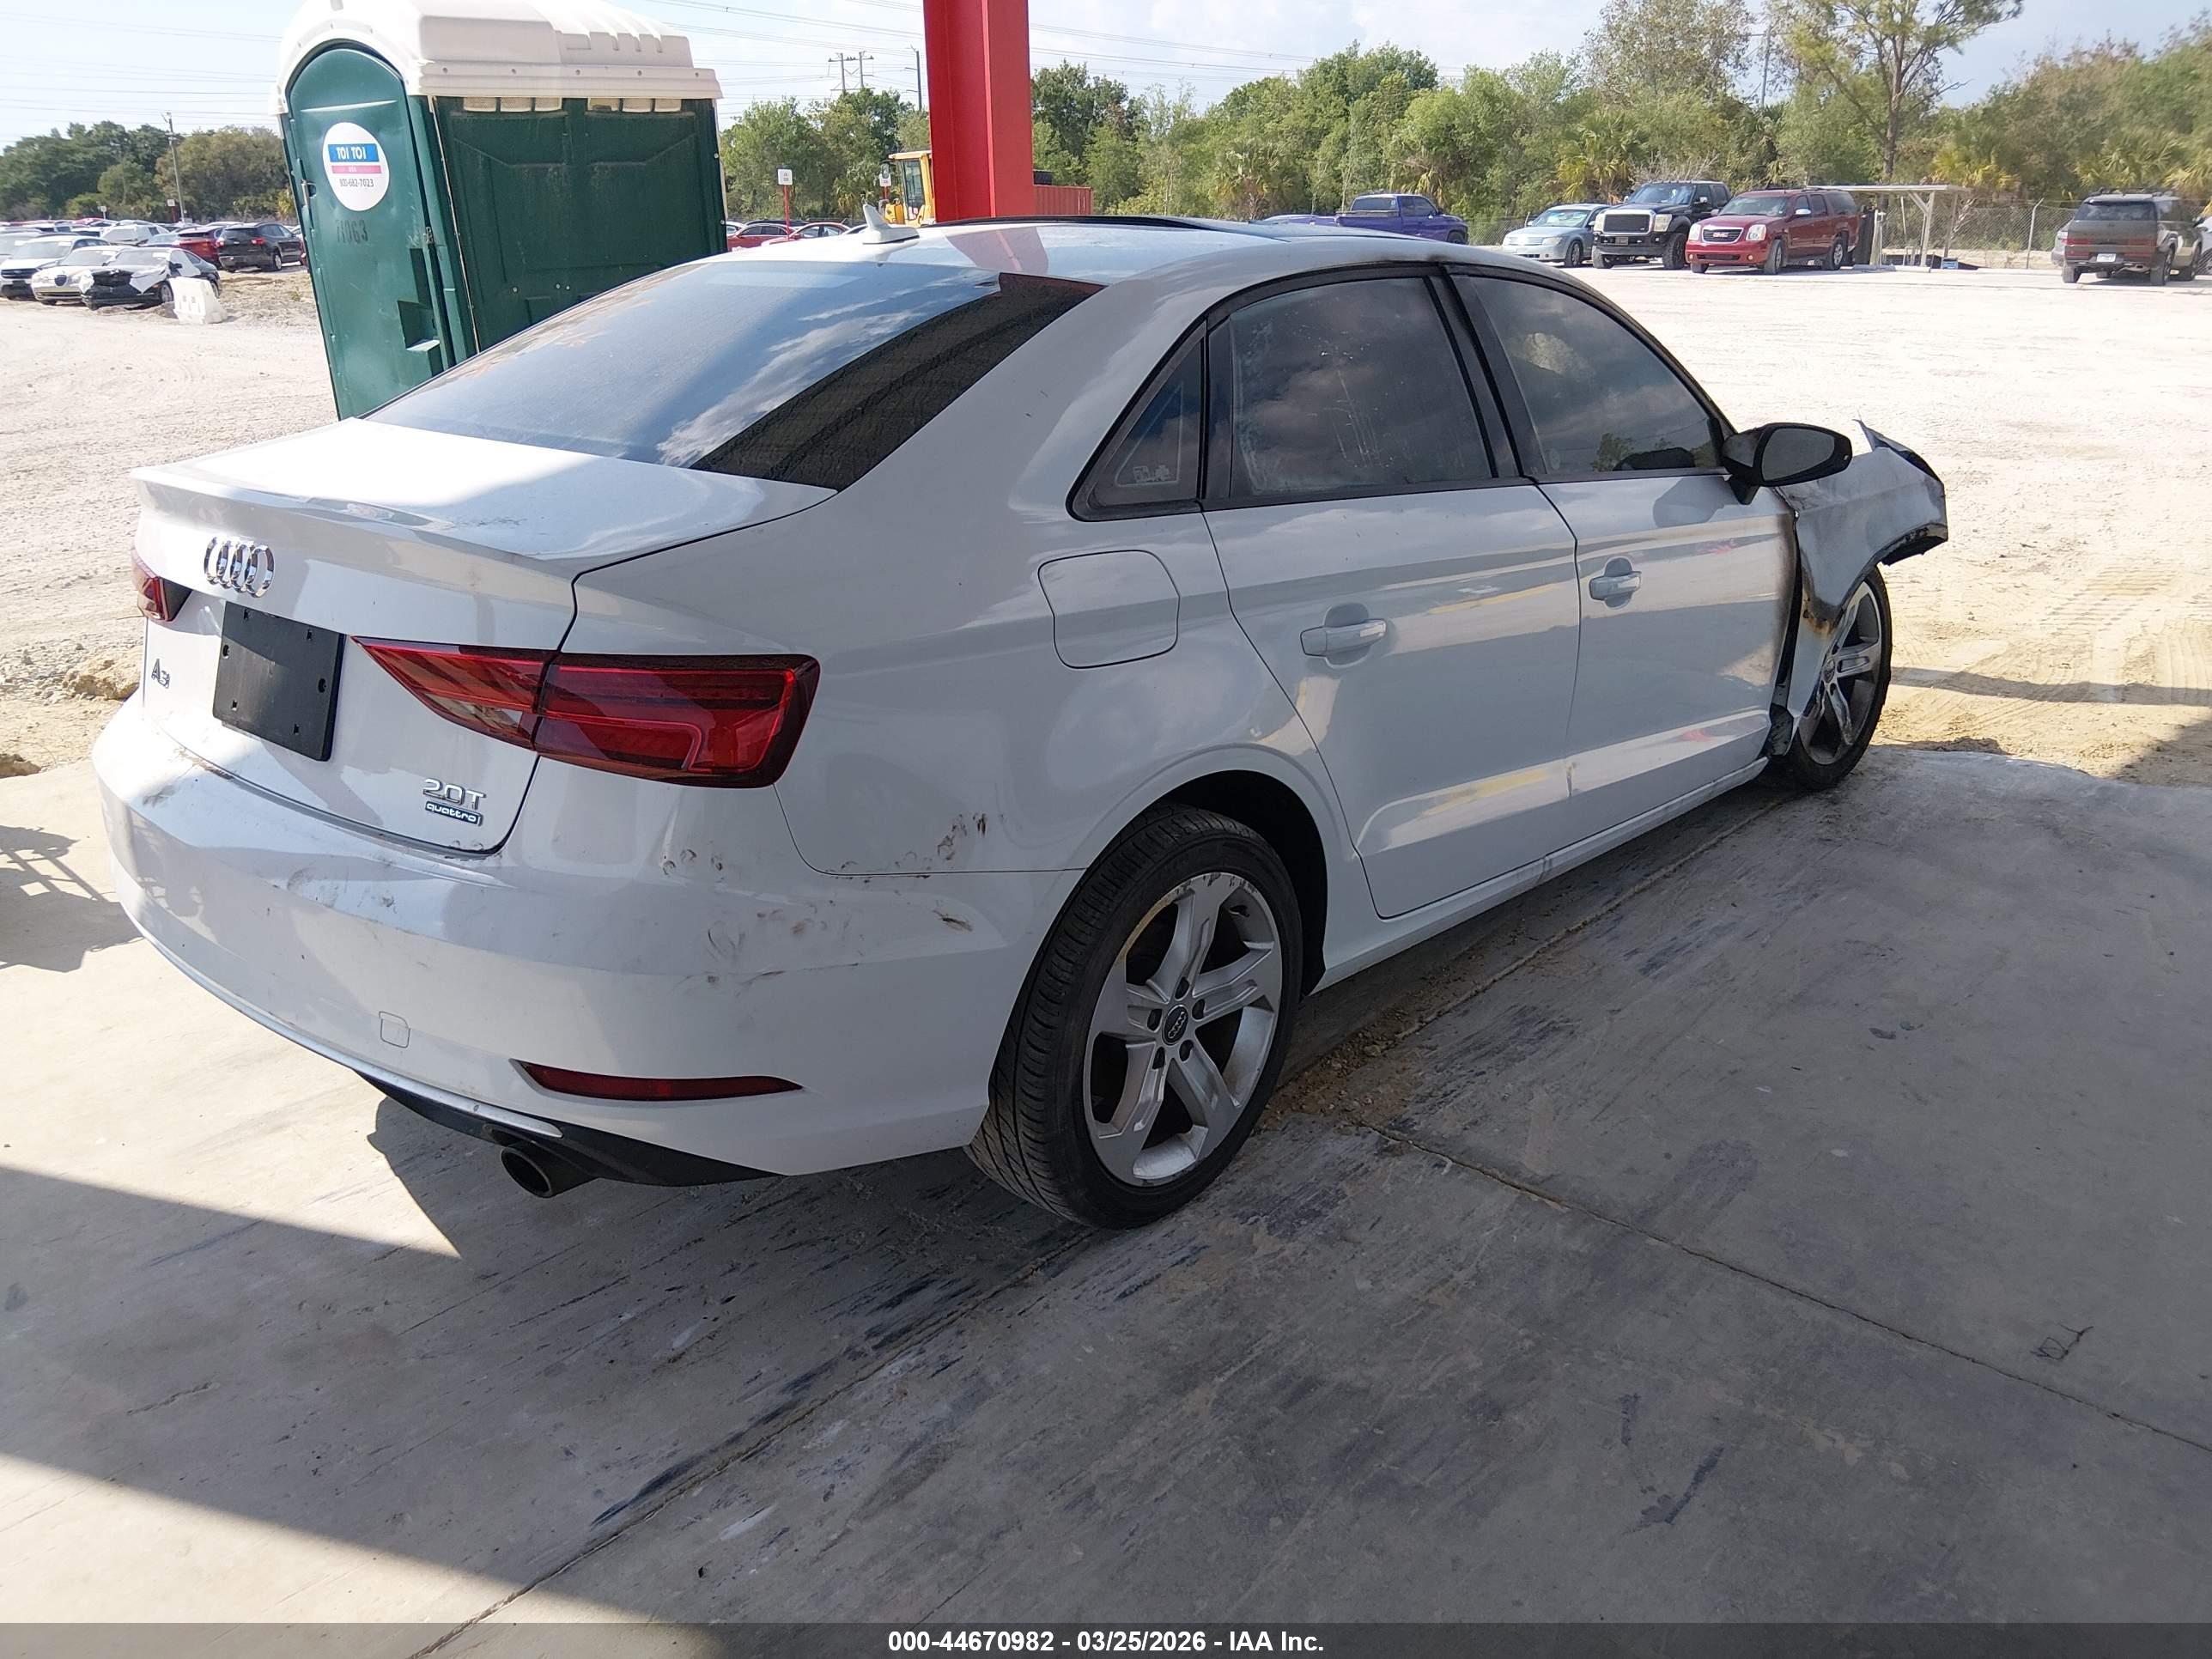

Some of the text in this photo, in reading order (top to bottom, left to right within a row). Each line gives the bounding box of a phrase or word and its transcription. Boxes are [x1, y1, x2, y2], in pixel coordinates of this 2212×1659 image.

[336, 146, 368, 160] TOI TOI
[150, 658, 171, 689] A3
[426, 802, 477, 823] quattro
